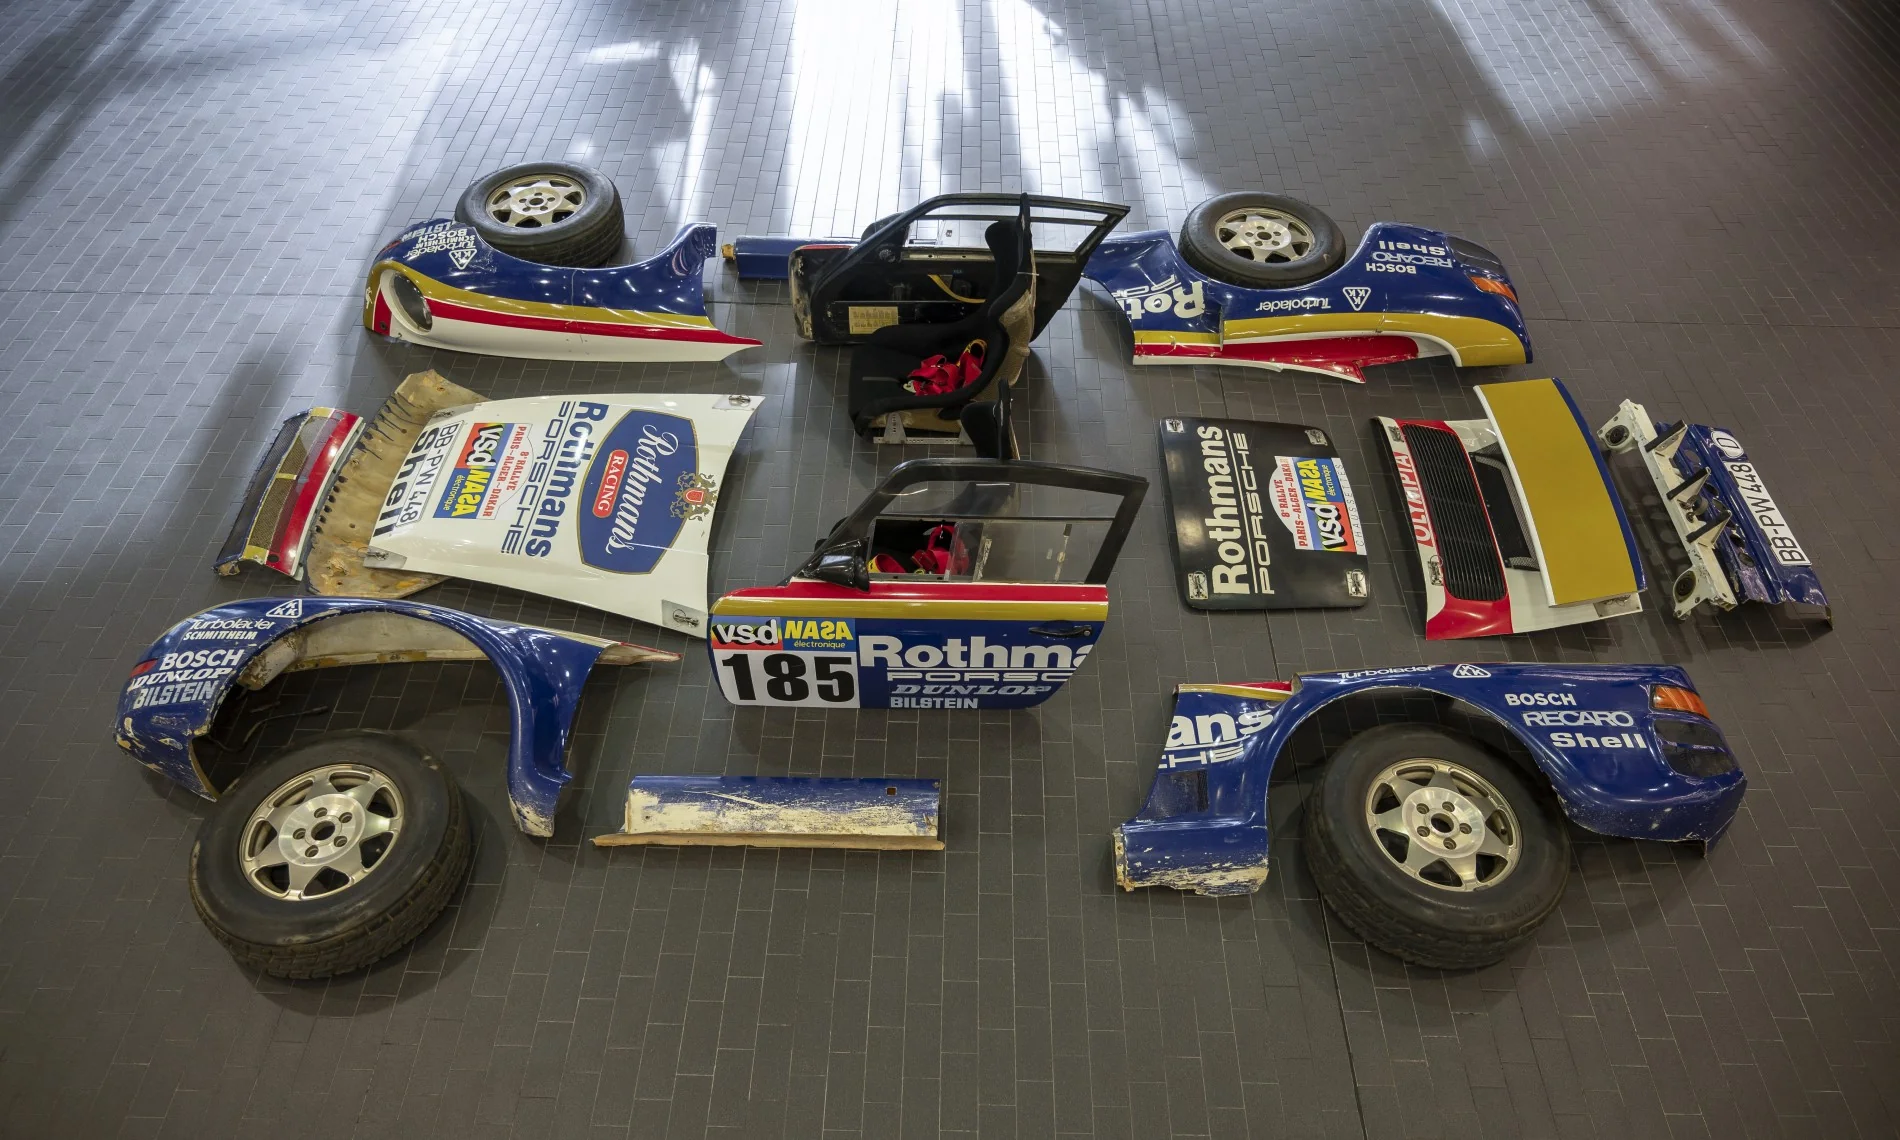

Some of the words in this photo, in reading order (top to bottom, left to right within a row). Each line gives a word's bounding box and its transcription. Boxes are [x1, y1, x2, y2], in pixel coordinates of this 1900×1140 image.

[402, 240, 476, 259] Turbolader
[418, 228, 467, 241] BOSCH
[1379, 240, 1446, 256] Shell
[1366, 262, 1416, 274] BOSCH
[1371, 251, 1453, 268] RECARO
[1117, 281, 1206, 319] Rot
[1256, 297, 1331, 311] Turbolader
[416, 423, 460, 486] BB-PW
[467, 424, 504, 467] vsd
[373, 427, 440, 538] Shell
[500, 401, 571, 554] PORSCHE
[506, 460, 526, 492] RALLYE
[524, 401, 608, 558] Rothmans
[598, 455, 625, 512] RACING
[605, 424, 679, 556] Rothmans
[1296, 459, 1327, 502] NASA
[1321, 464, 1336, 497] électronique
[1730, 463, 1762, 492] 448
[400, 491, 427, 523] 448
[443, 474, 465, 511] électronique
[451, 468, 491, 517] NASA
[1274, 479, 1289, 509] RALLYE
[1334, 463, 1365, 547] CHAUSSETTES
[1394, 453, 1432, 542] OLYMPIA
[1197, 426, 1251, 595] Rothmans
[1235, 433, 1275, 595] PORSCHE
[1307, 503, 1346, 547] vsd
[1748, 496, 1805, 564] BB-PW
[190, 618, 276, 631] Turbolader
[714, 619, 779, 645] vsd
[784, 620, 854, 641] NASA
[159, 649, 245, 671] BOSCH
[794, 640, 846, 649] électronique
[127, 668, 233, 692] DUNLOP
[722, 653, 856, 702] 185
[1337, 665, 1433, 679] Turbolader
[133, 680, 219, 709] BILSTEIN
[890, 697, 978, 709] BILSTEIN
[891, 684, 1052, 695] DUNLOP
[1504, 691, 1577, 707] BOSCH
[1165, 710, 1274, 748] ans
[1521, 711, 1635, 728] RECARO
[1552, 731, 1647, 750] Shell
[1158, 744, 1244, 769] HE
